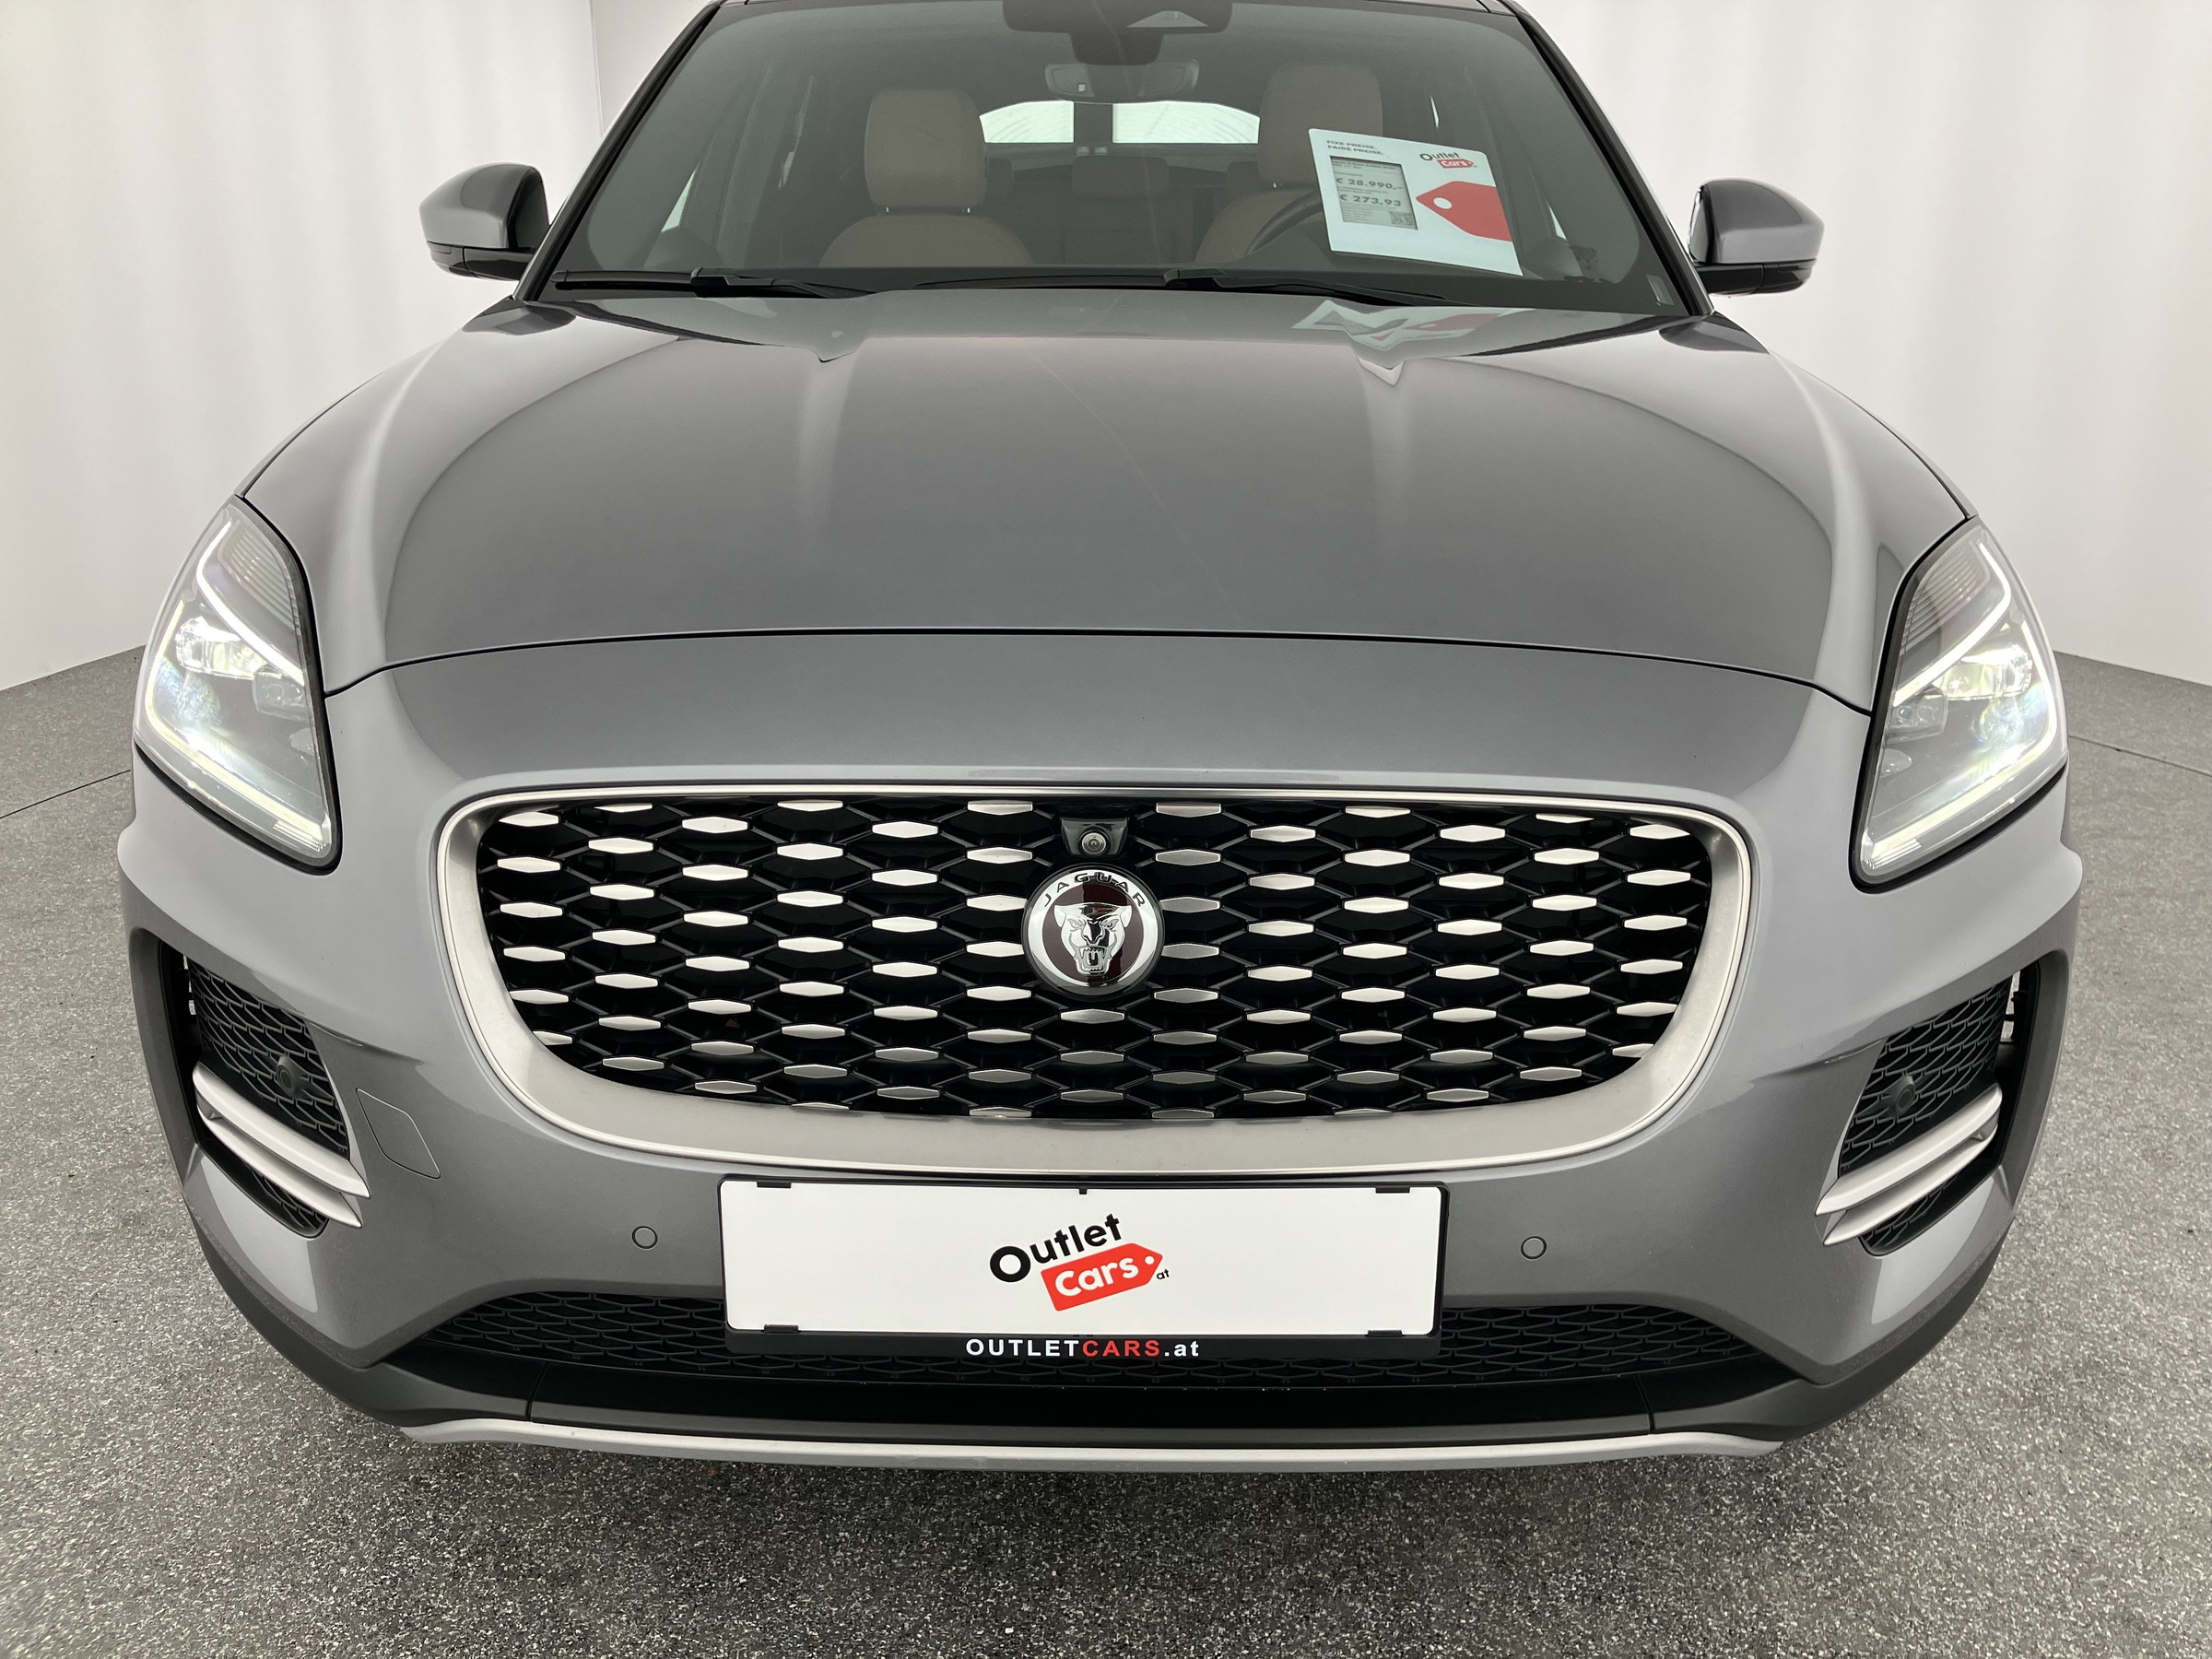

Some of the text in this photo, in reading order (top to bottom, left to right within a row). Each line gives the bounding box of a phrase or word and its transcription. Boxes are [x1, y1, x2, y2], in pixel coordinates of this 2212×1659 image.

[1419, 152, 1460, 161] Outlet
[1043, 871, 1146, 908] JAGUAR
[990, 1213, 1122, 1283] Outlet
[1054, 1257, 1170, 1297] Cars at
[966, 1338, 1199, 1358] OUTLETCARS.at
